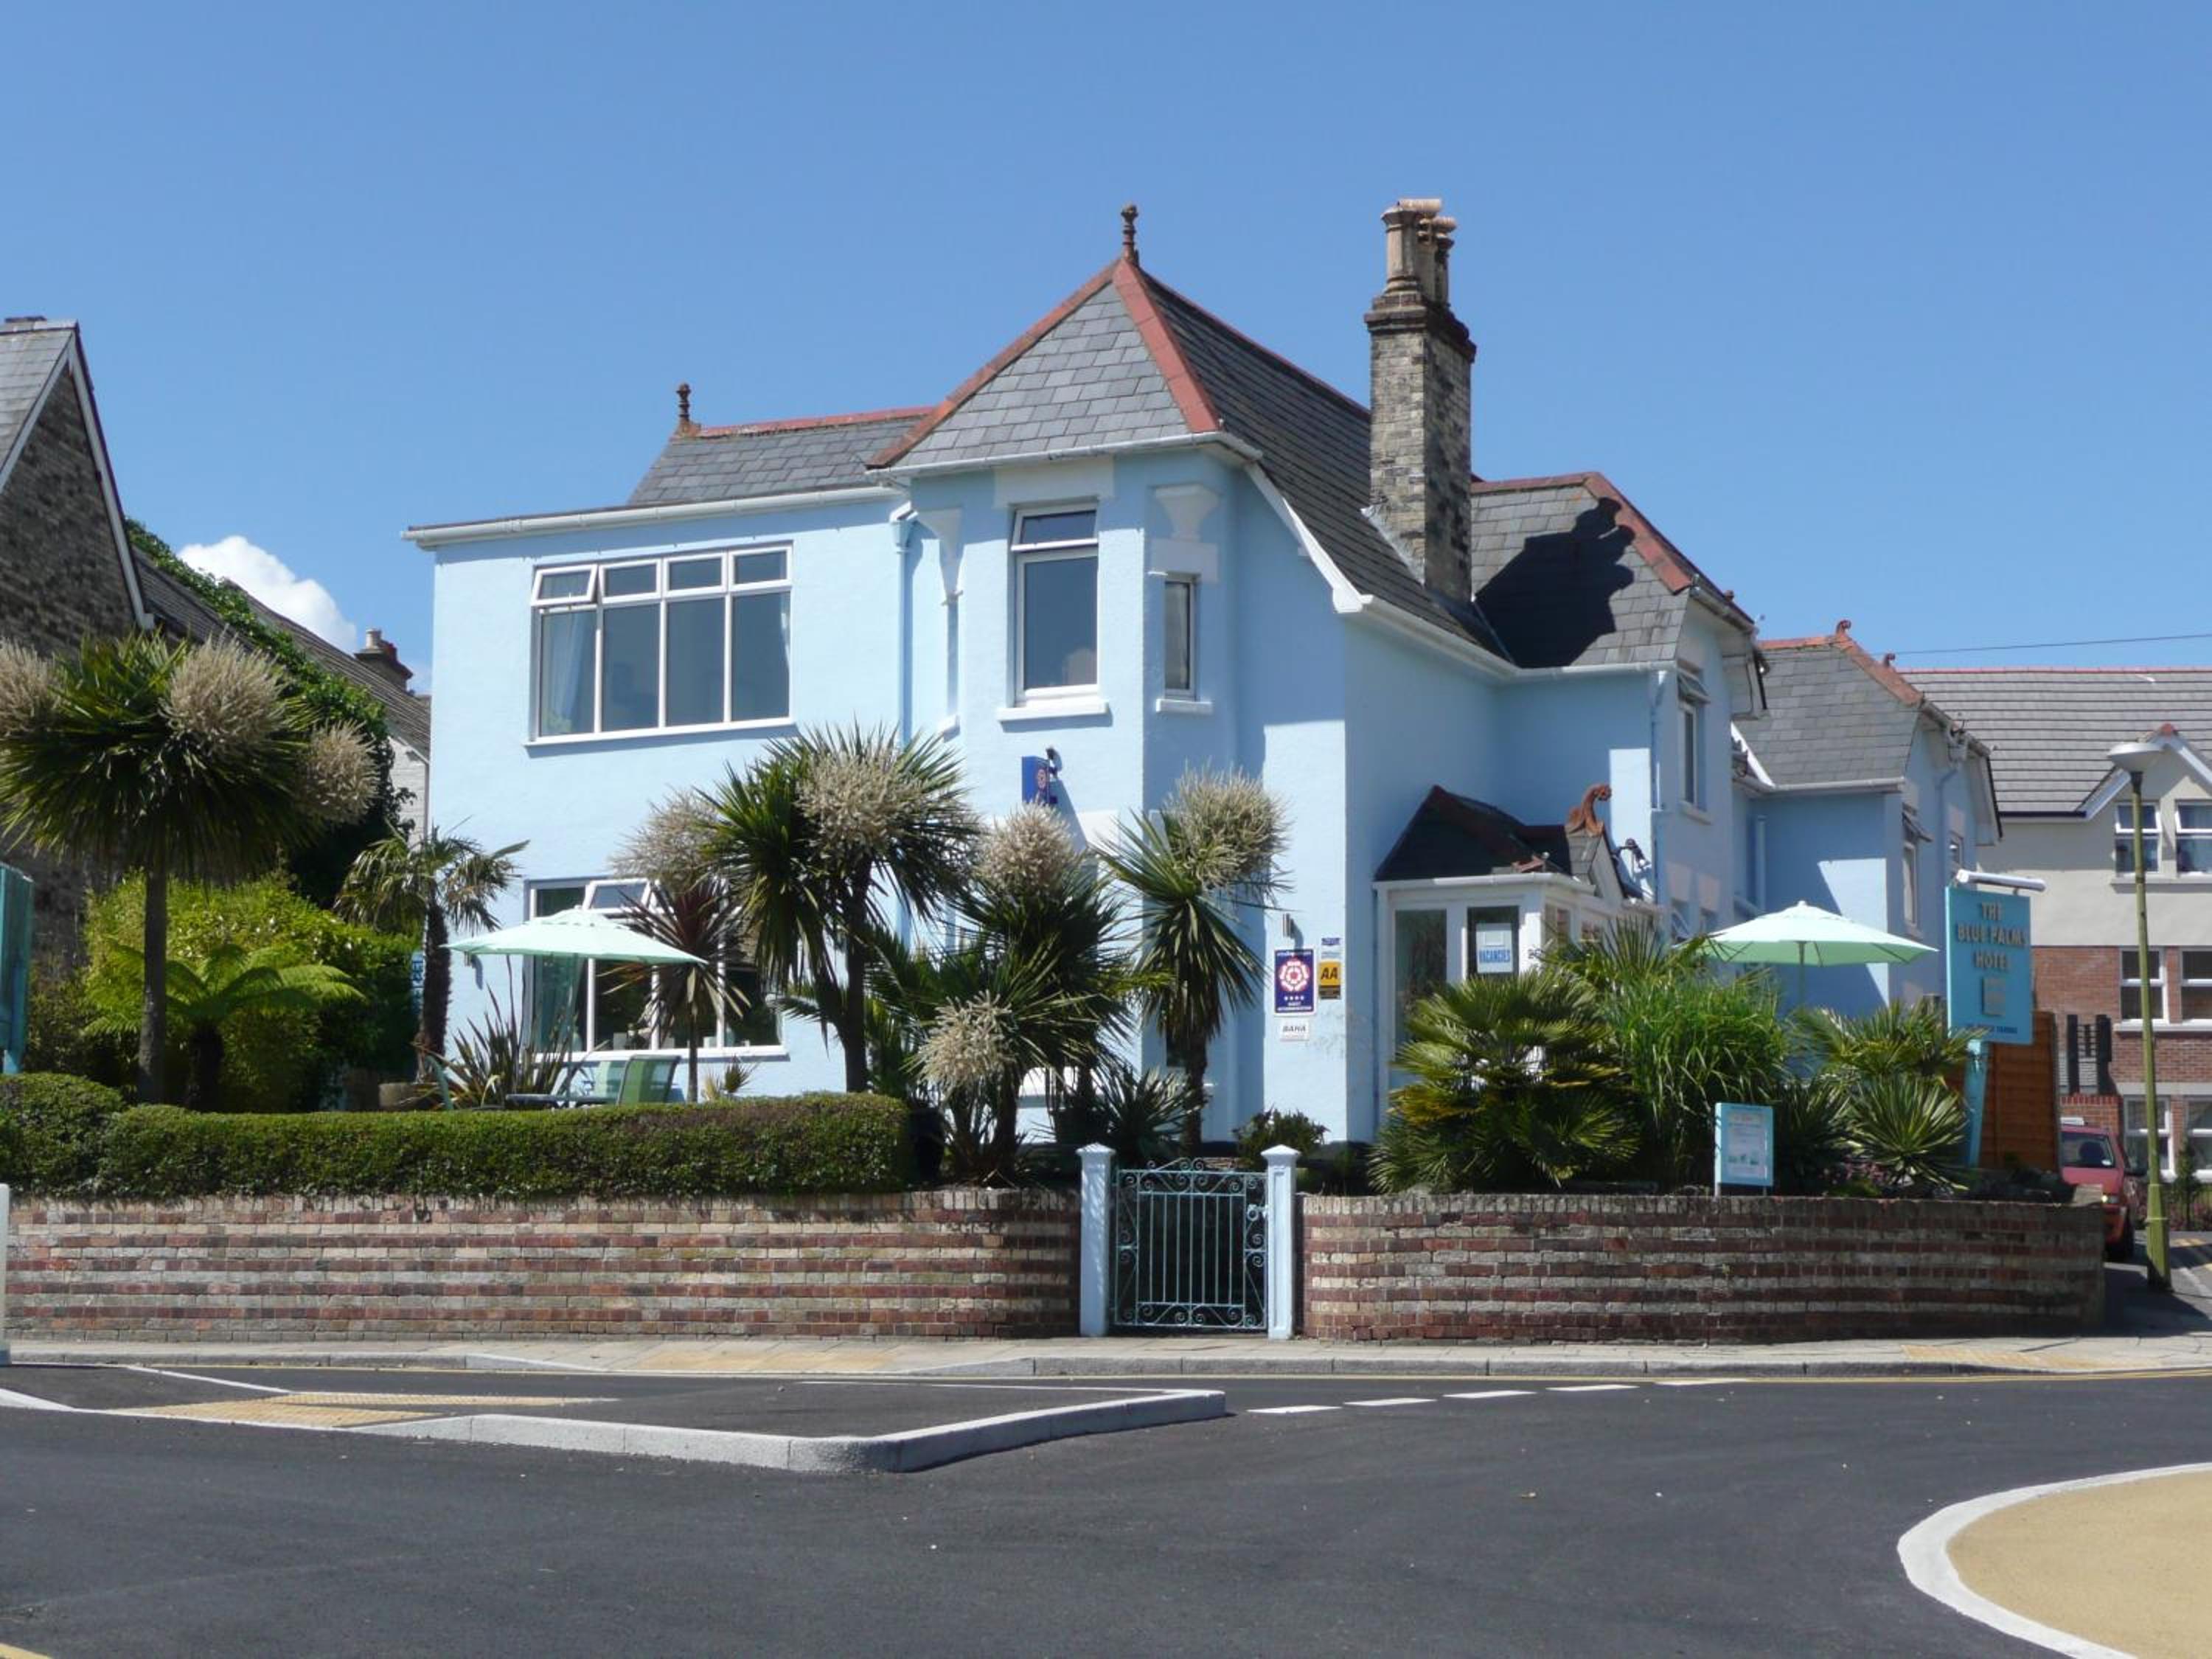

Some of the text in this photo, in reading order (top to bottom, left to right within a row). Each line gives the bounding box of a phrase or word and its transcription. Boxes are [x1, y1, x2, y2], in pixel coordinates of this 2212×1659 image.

[1980, 901, 2002, 921] THE
[1958, 922, 1984, 944] BLUE
[1479, 949, 1511, 963] VACANCIES
[1975, 950, 2008, 971] HOTEL
[1321, 967, 1339, 980] AA
